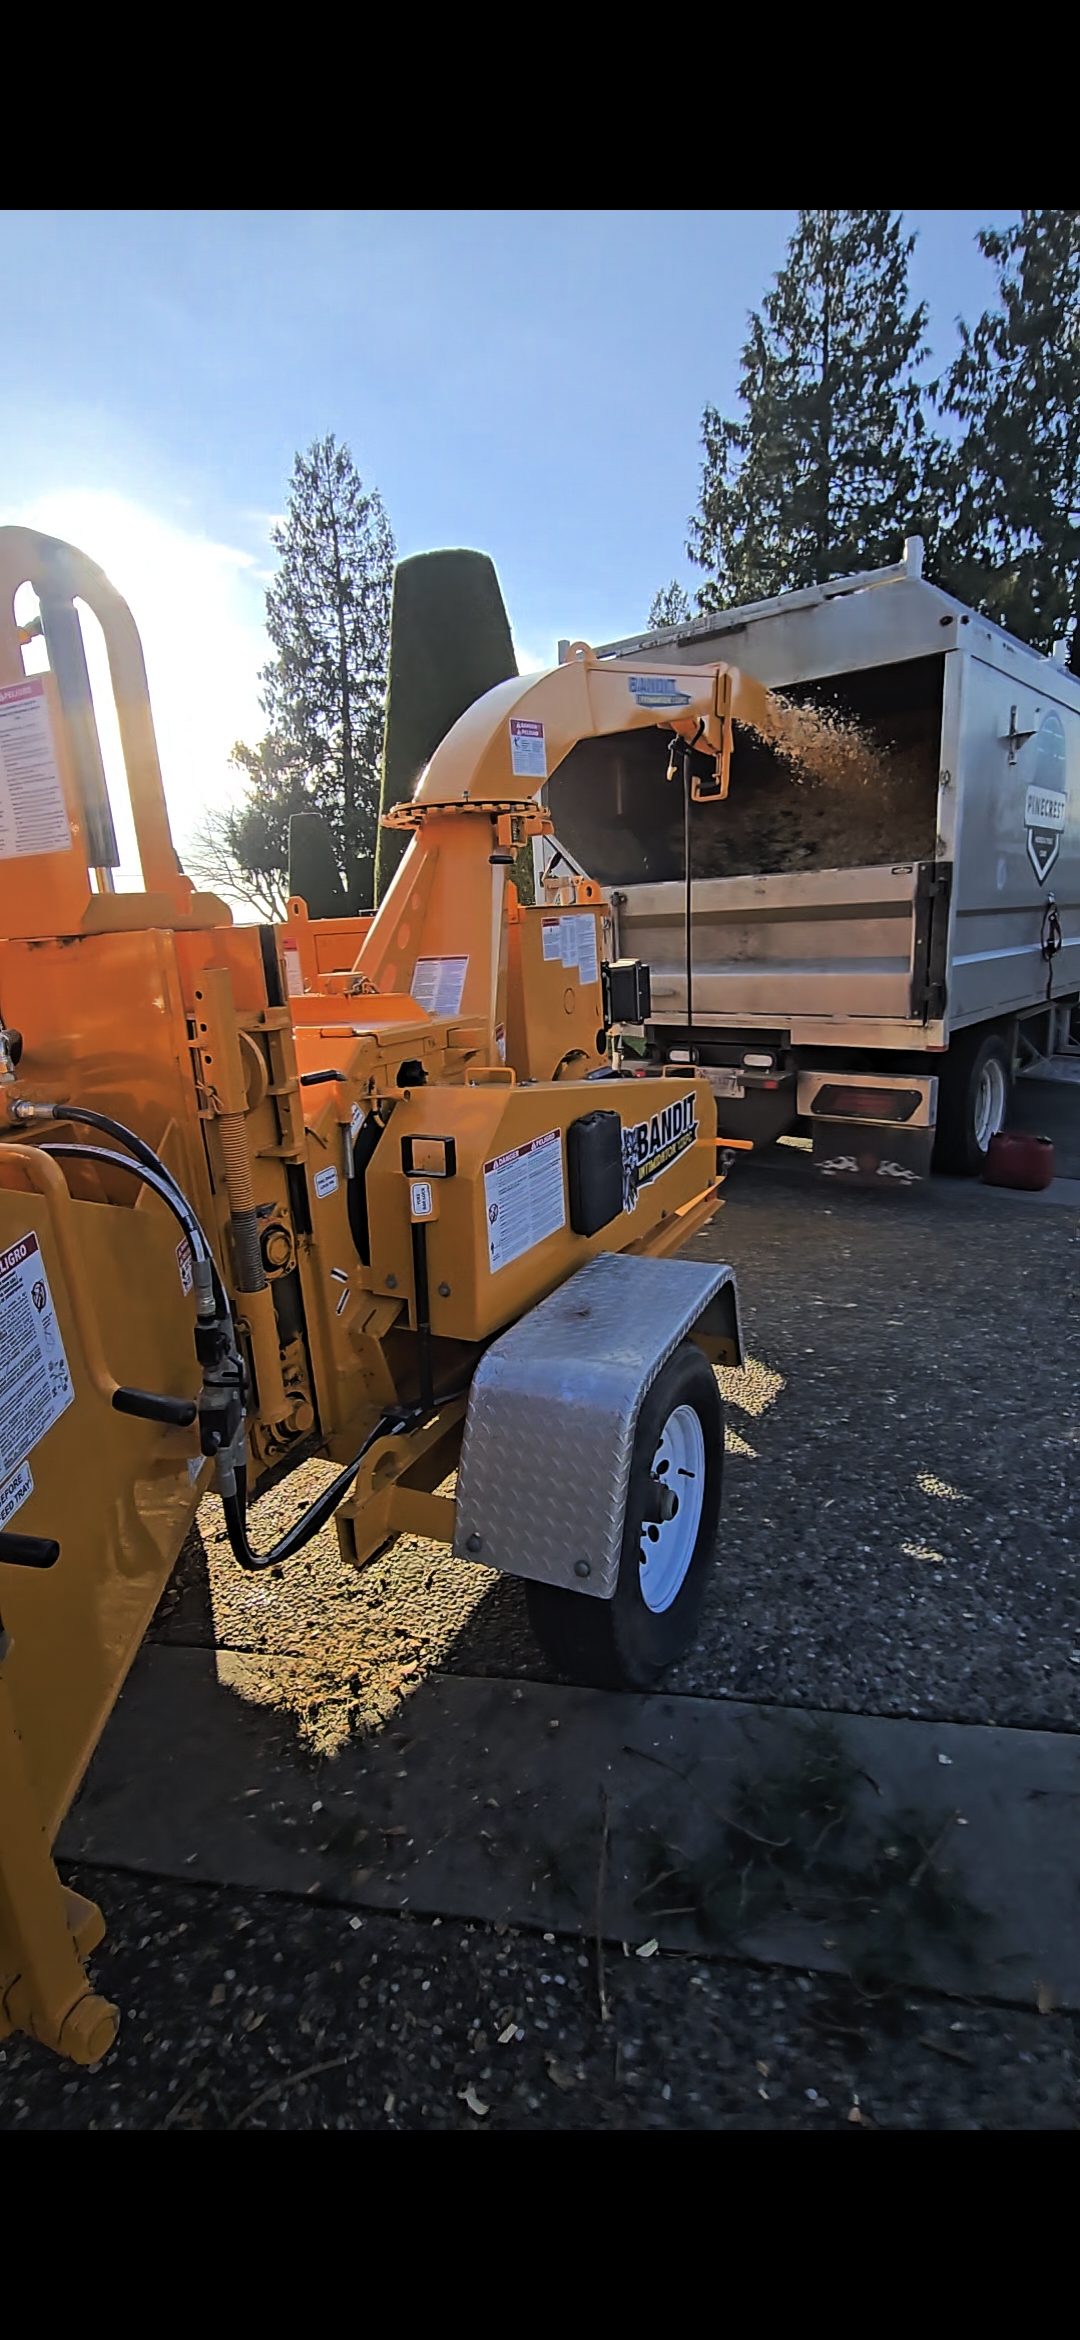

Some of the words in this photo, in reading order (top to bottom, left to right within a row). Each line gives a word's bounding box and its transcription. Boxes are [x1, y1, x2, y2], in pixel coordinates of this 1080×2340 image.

[628, 677, 676, 692] BANDIT
[1027, 795, 1064, 819] PINECREST
[635, 1092, 696, 1161] BANDIT
[498, 1150, 520, 1166] DANGER
[0, 1244, 27, 1274] LIGRO
[0, 1473, 24, 1508] EFORE
[0, 1501, 15, 1521] EED
[14, 1480, 31, 1503] TRAY
